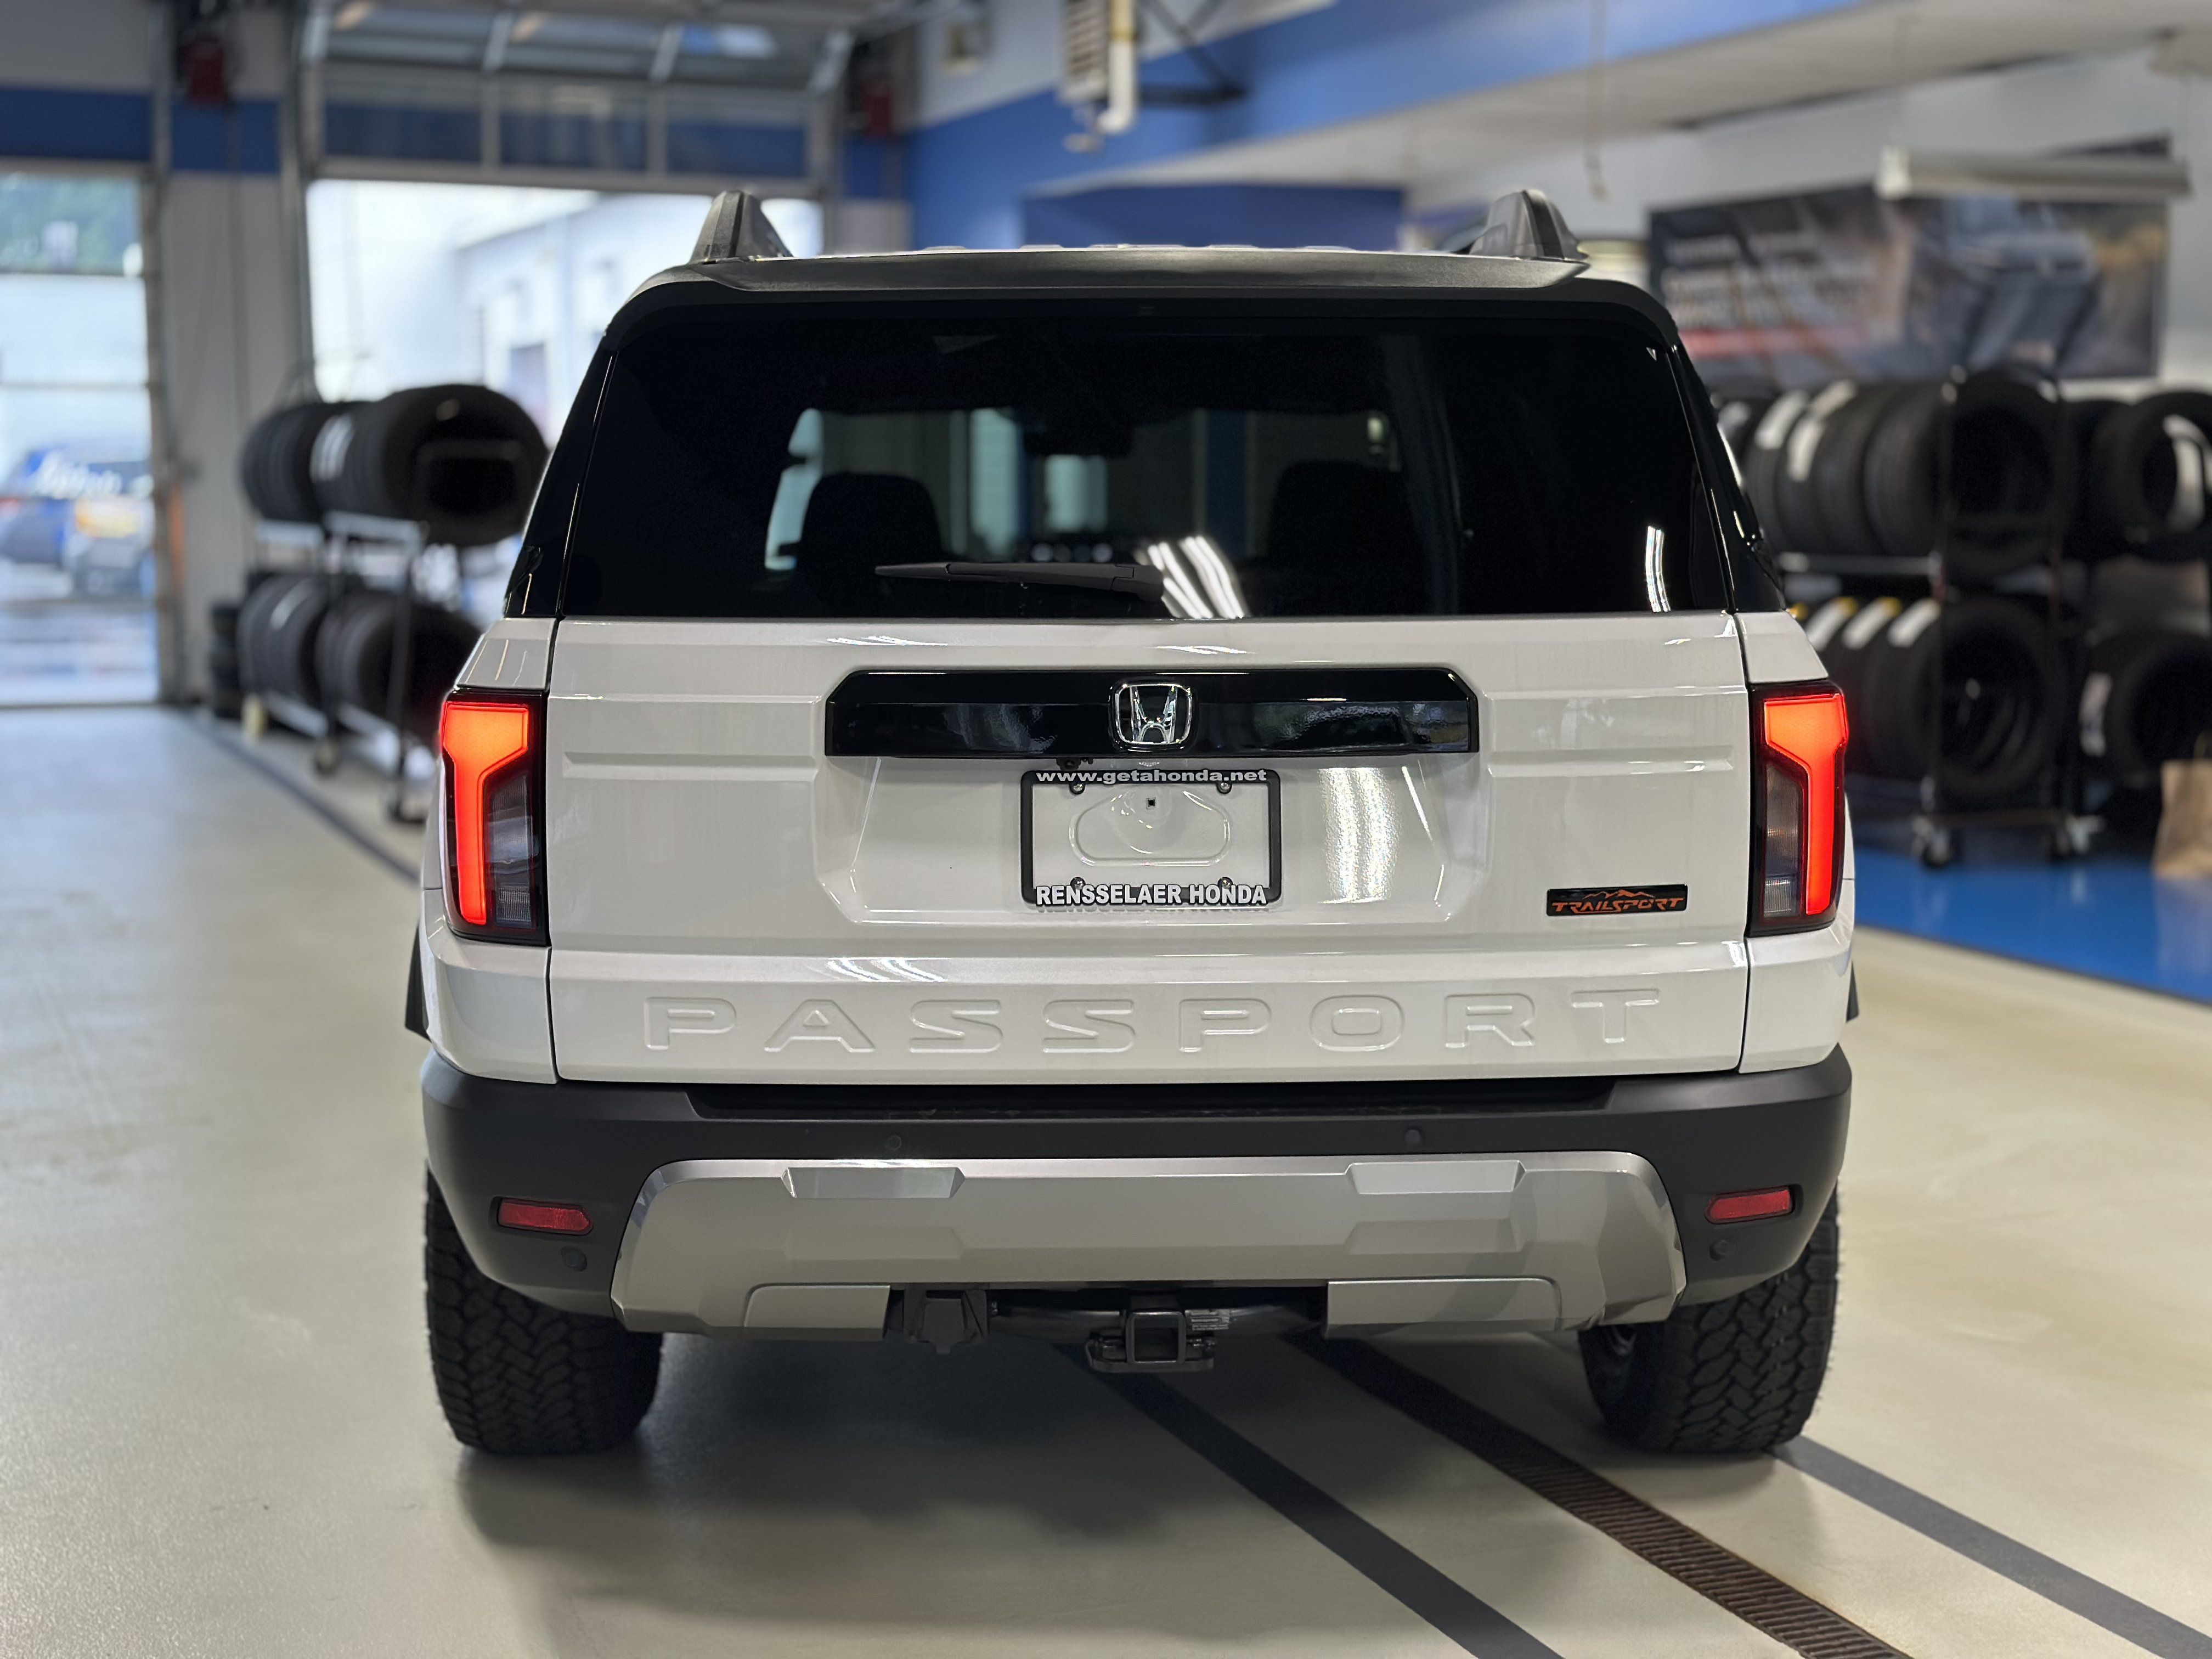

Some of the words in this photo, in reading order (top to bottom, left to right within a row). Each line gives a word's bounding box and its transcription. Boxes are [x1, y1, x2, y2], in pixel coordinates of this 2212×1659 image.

[1036, 770, 1267, 785] www.getahonda.net
[1036, 884, 1181, 905] RENSSELAER
[1189, 884, 1267, 905] HONDA
[1551, 897, 1684, 915] TRAILSPORT
[644, 989, 1660, 1054] PASSPORT
